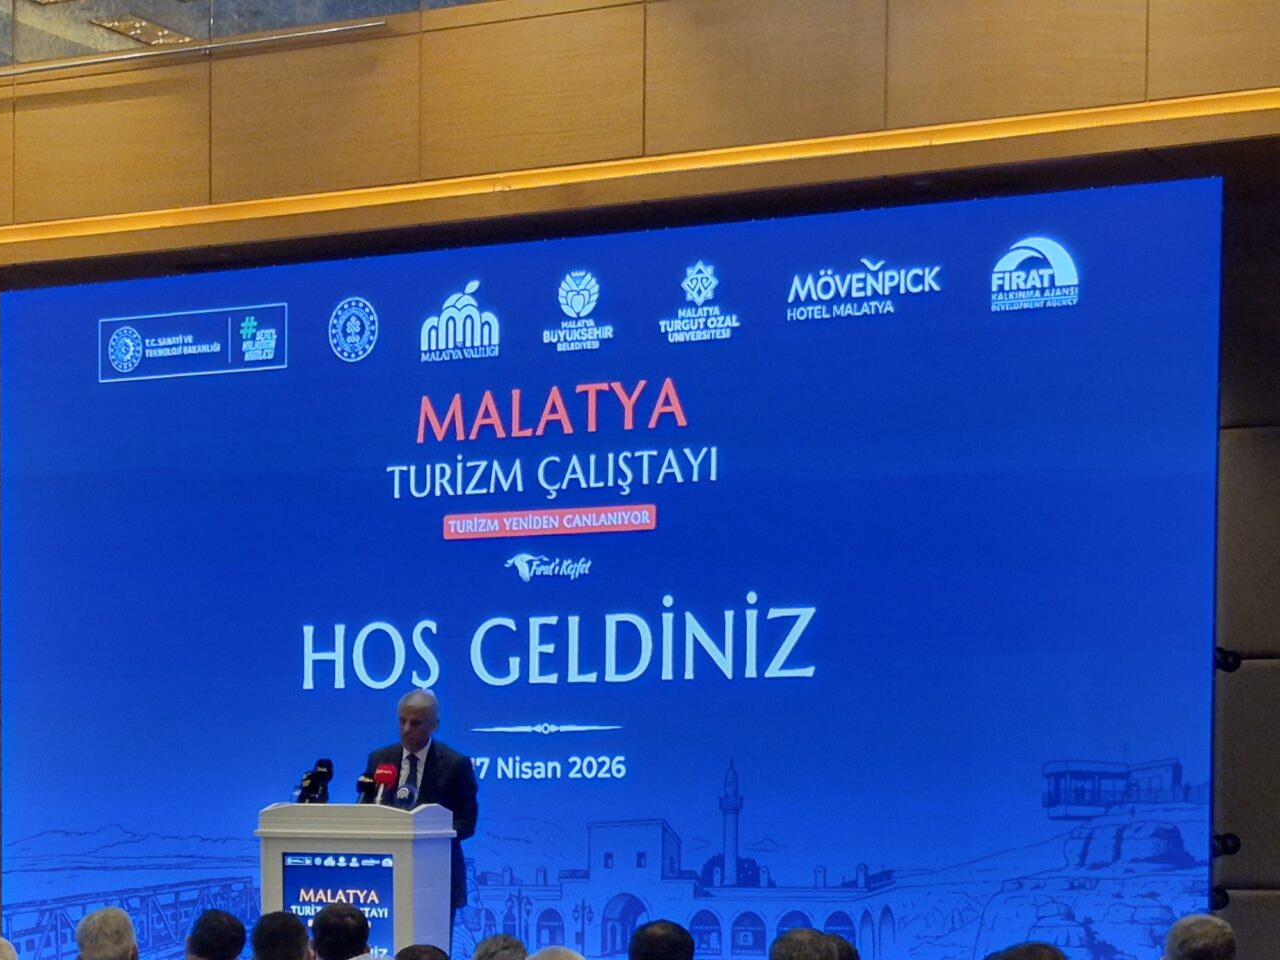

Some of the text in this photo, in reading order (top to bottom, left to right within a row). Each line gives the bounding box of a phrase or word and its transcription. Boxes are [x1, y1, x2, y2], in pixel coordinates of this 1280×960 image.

[787, 262, 941, 303] MÖVENPICK
[991, 268, 1053, 292] FIRAT
[678, 305, 720, 319] MALATYA
[787, 300, 895, 321] HOTEL MALATYA
[659, 317, 706, 333] TURGUT
[420, 348, 463, 362] MALATYA
[416, 377, 688, 444] MALATYA
[387, 446, 718, 500] TURİZM ÇALIŞTAYI
[448, 511, 651, 534] TURİZM YENİDEN CANLANIYOR
[470, 591, 817, 687] GELDİNİZ
[497, 755, 561, 780] Nisan
[567, 755, 626, 780] 2026
[299, 888, 379, 904] MALATYA
